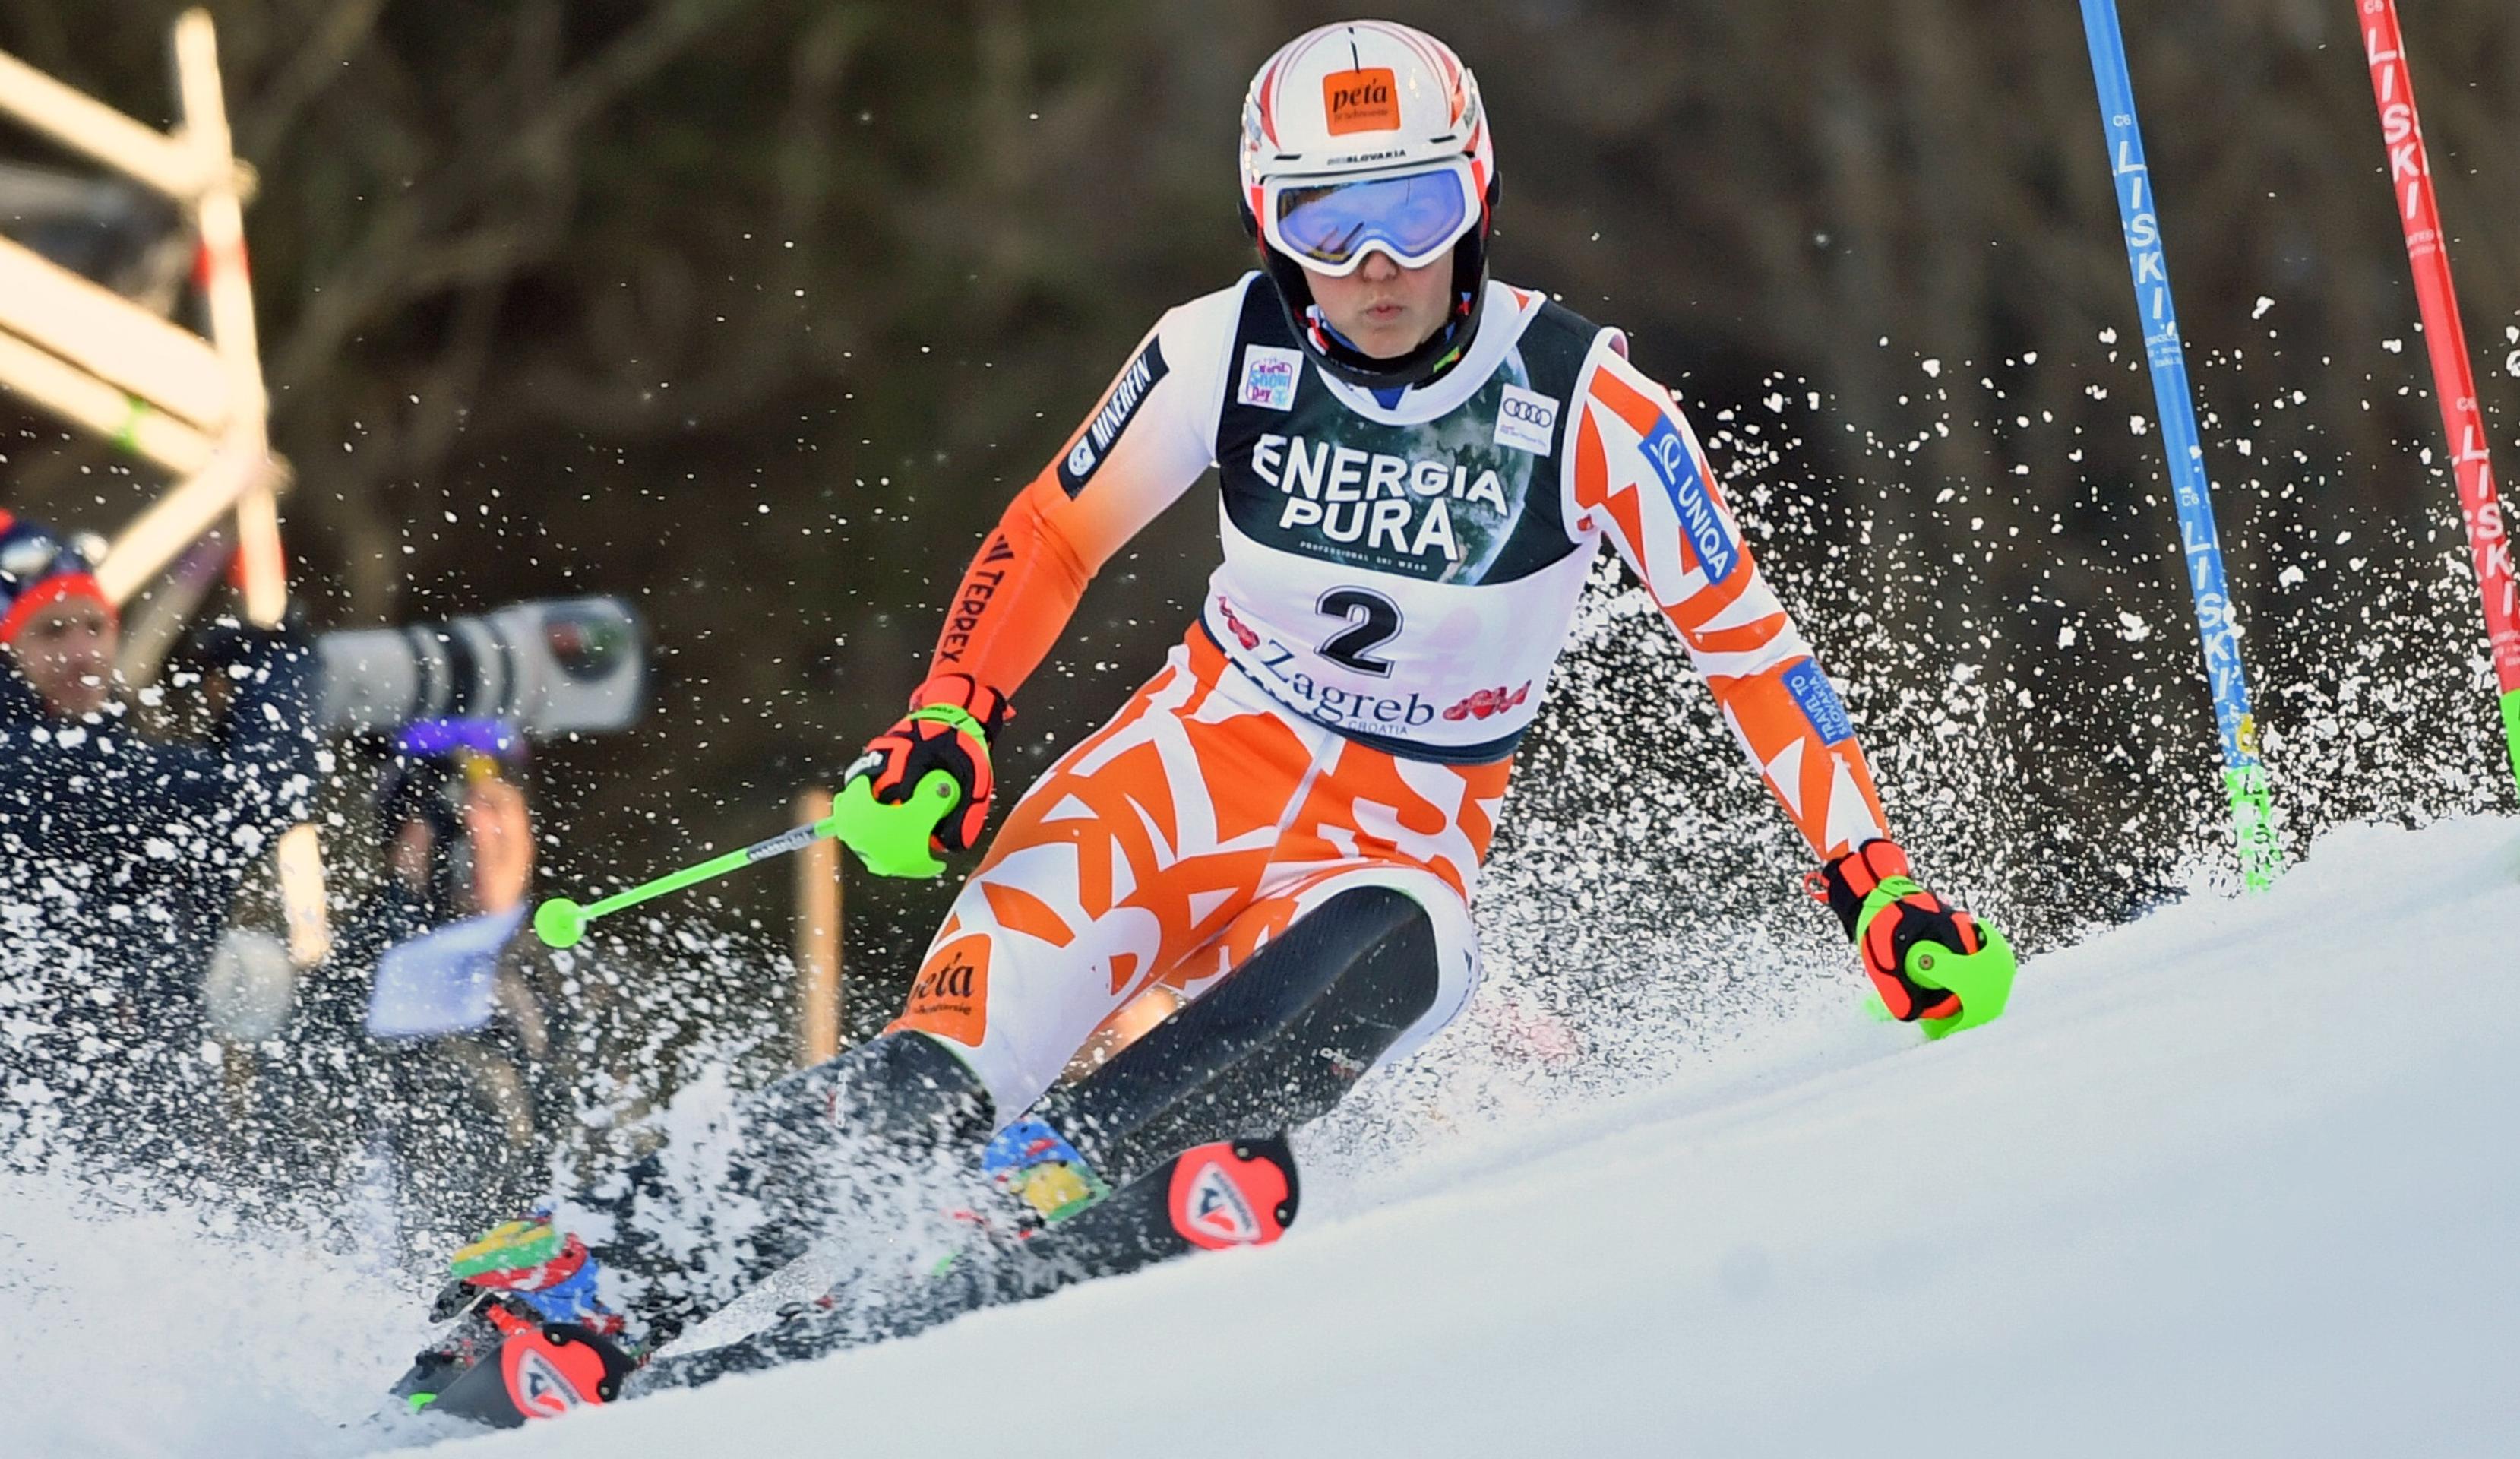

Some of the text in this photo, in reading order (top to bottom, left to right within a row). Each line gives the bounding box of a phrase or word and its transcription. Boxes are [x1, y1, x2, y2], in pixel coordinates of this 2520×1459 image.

[2367, 27, 2420, 220] LISKI
[2117, 140, 2165, 320] LISKI
[1092, 353, 1152, 453] MINERFIN
[1252, 433, 1509, 517] ENERGIA
[2462, 424, 2515, 617] LISKI
[1279, 496, 1459, 561] PURA
[1678, 475, 1729, 579] UNIQA
[936, 570, 1005, 666] TERREX
[1313, 584, 1405, 679] 2
[2185, 521, 2231, 702] LISKI
[1261, 639, 1434, 726] Zagreb
[1348, 720, 1409, 735] CROATIA
[1791, 675, 1837, 740] TRAVEL TO
